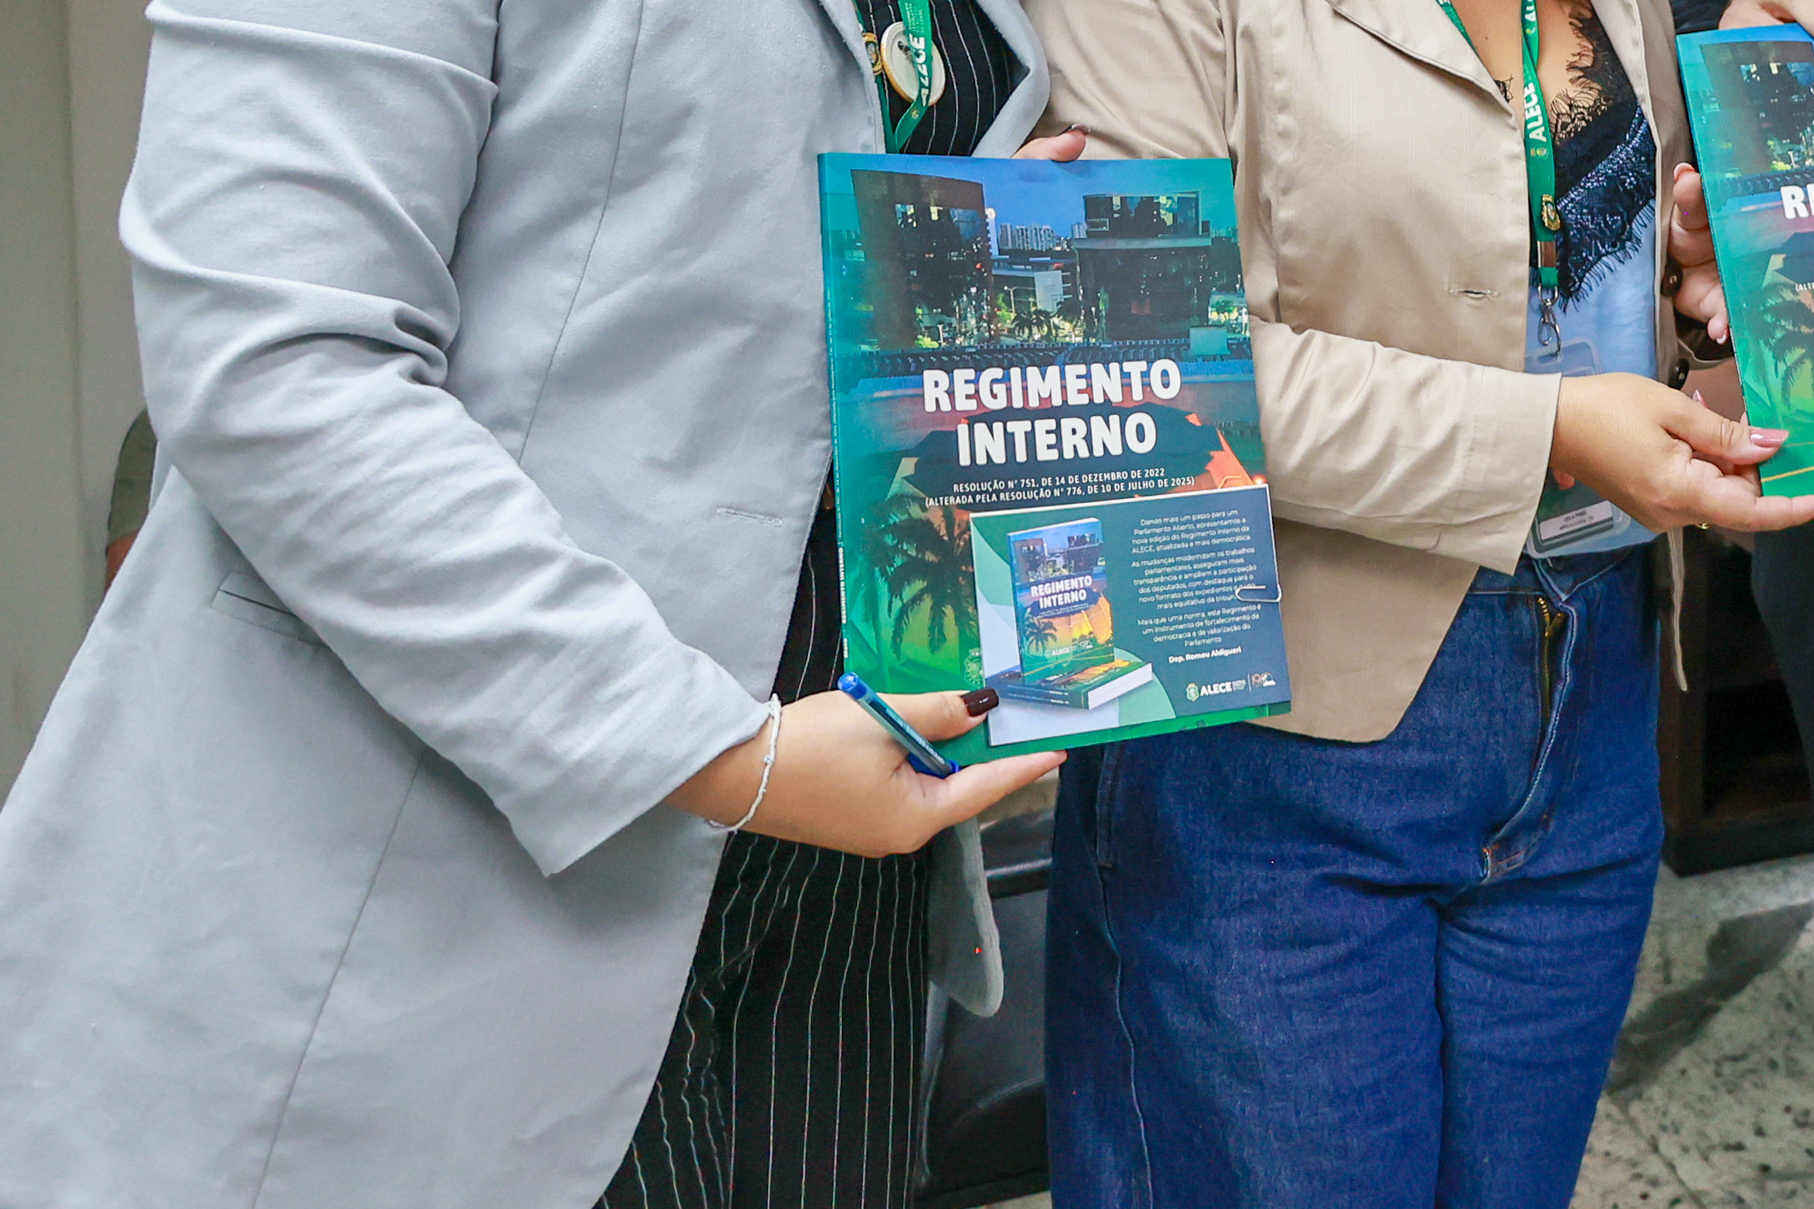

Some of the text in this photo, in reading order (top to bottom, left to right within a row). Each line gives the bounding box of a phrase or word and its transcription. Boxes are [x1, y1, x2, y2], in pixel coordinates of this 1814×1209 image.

[1523, 82, 1548, 142] ALECE
[923, 359, 1182, 412] REGIMENTO
[957, 412, 1157, 466] INTERNO
[925, 495, 973, 507] (ALTERADA
[976, 493, 997, 503] PELA
[1000, 488, 1051, 501] RESOLUÇÃO
[1088, 485, 1098, 494] DE
[1101, 484, 1111, 493] 10
[1114, 483, 1125, 492] DE
[1128, 480, 1155, 490] JULHO
[1158, 479, 1168, 488] DE
[1171, 476, 1194, 487] 2025)
[954, 480, 1005, 492] RESOLUÇÃO
[1041, 477, 1052, 486] DE
[1055, 477, 1065, 485] 14
[1068, 475, 1079, 484] DE
[1082, 471, 1128, 483] DEZEMBRO
[1131, 470, 1142, 479] DE
[1145, 468, 1165, 478] 2022
[1031, 575, 1093, 598] REGIMENTO
[1039, 590, 1087, 609] INTERNO
[1200, 681, 1233, 697] ALECE
